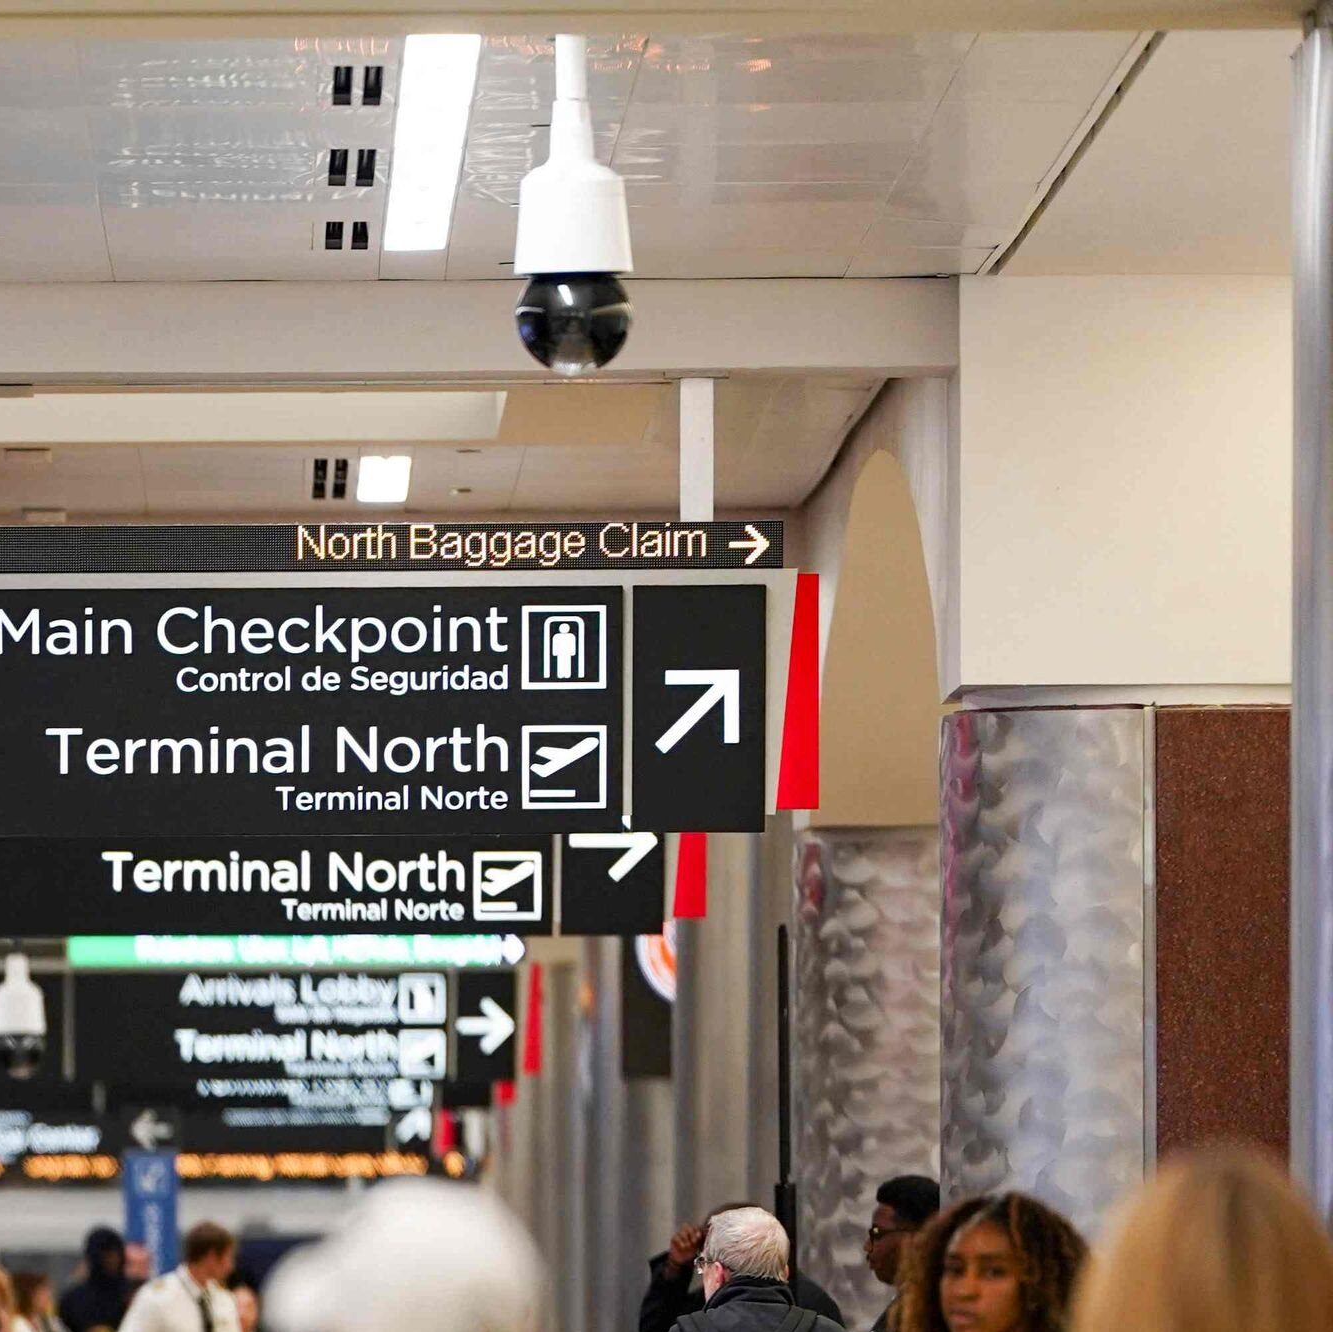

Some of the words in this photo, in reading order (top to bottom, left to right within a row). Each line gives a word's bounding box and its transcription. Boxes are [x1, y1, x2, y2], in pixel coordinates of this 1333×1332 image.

[297, 525, 397, 560] North
[409, 524, 586, 567] Baggage
[599, 522, 707, 558] Claim
[156, 604, 509, 664] Checkpoint
[176, 666, 291, 693] Control
[302, 666, 340, 692] de
[351, 664, 508, 696] Seguridad
[45, 725, 310, 775] Terminal
[337, 723, 509, 774] North
[275, 785, 408, 811] Terminal
[421, 786, 508, 811] Norte
[101, 850, 311, 893] Terminal
[329, 849, 466, 892] North
[281, 898, 387, 922] Terminal
[395, 898, 465, 922] Norte
[179, 972, 296, 1007] Arrivals
[300, 972, 399, 1012] Lobby
[174, 1028, 306, 1063] Terminal
[311, 1028, 399, 1061] North
